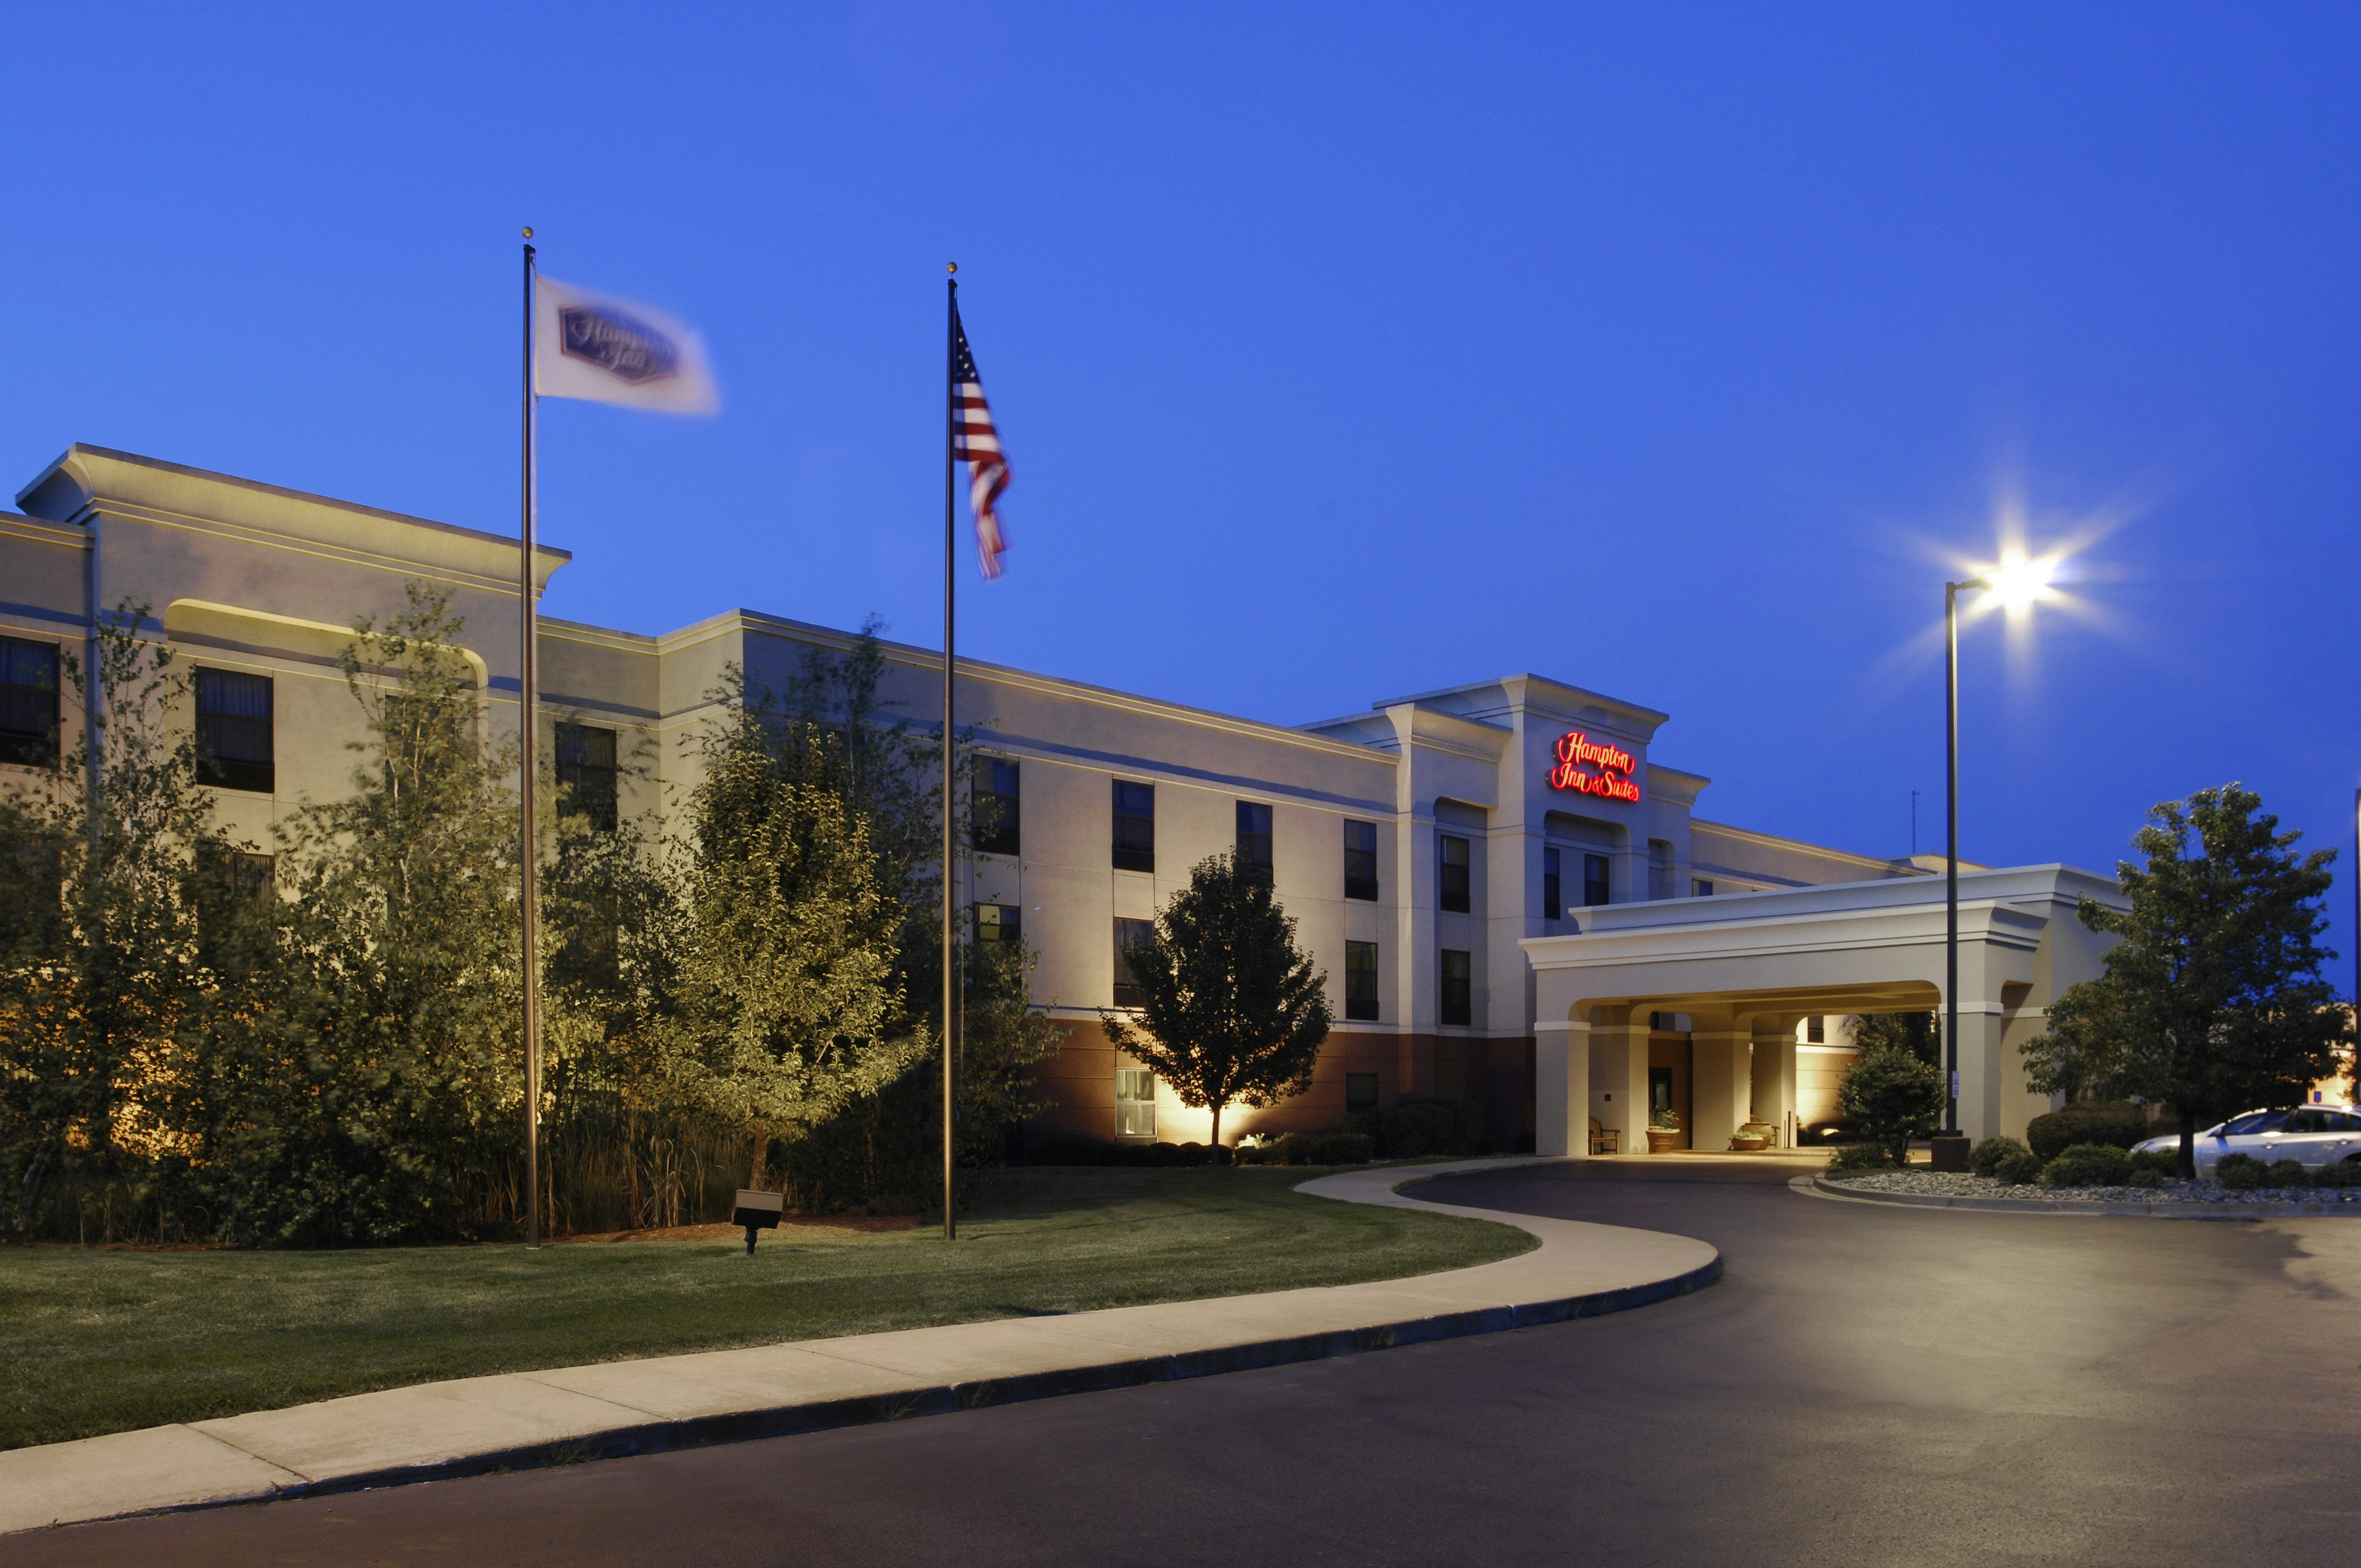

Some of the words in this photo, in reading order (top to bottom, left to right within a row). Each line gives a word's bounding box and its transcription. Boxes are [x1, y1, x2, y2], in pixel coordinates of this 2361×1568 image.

[1558, 731, 1635, 774] Hampton
[1552, 763, 1592, 793] Inn
[1592, 775, 1602, 796] &
[1600, 771, 1639, 802] Suites
